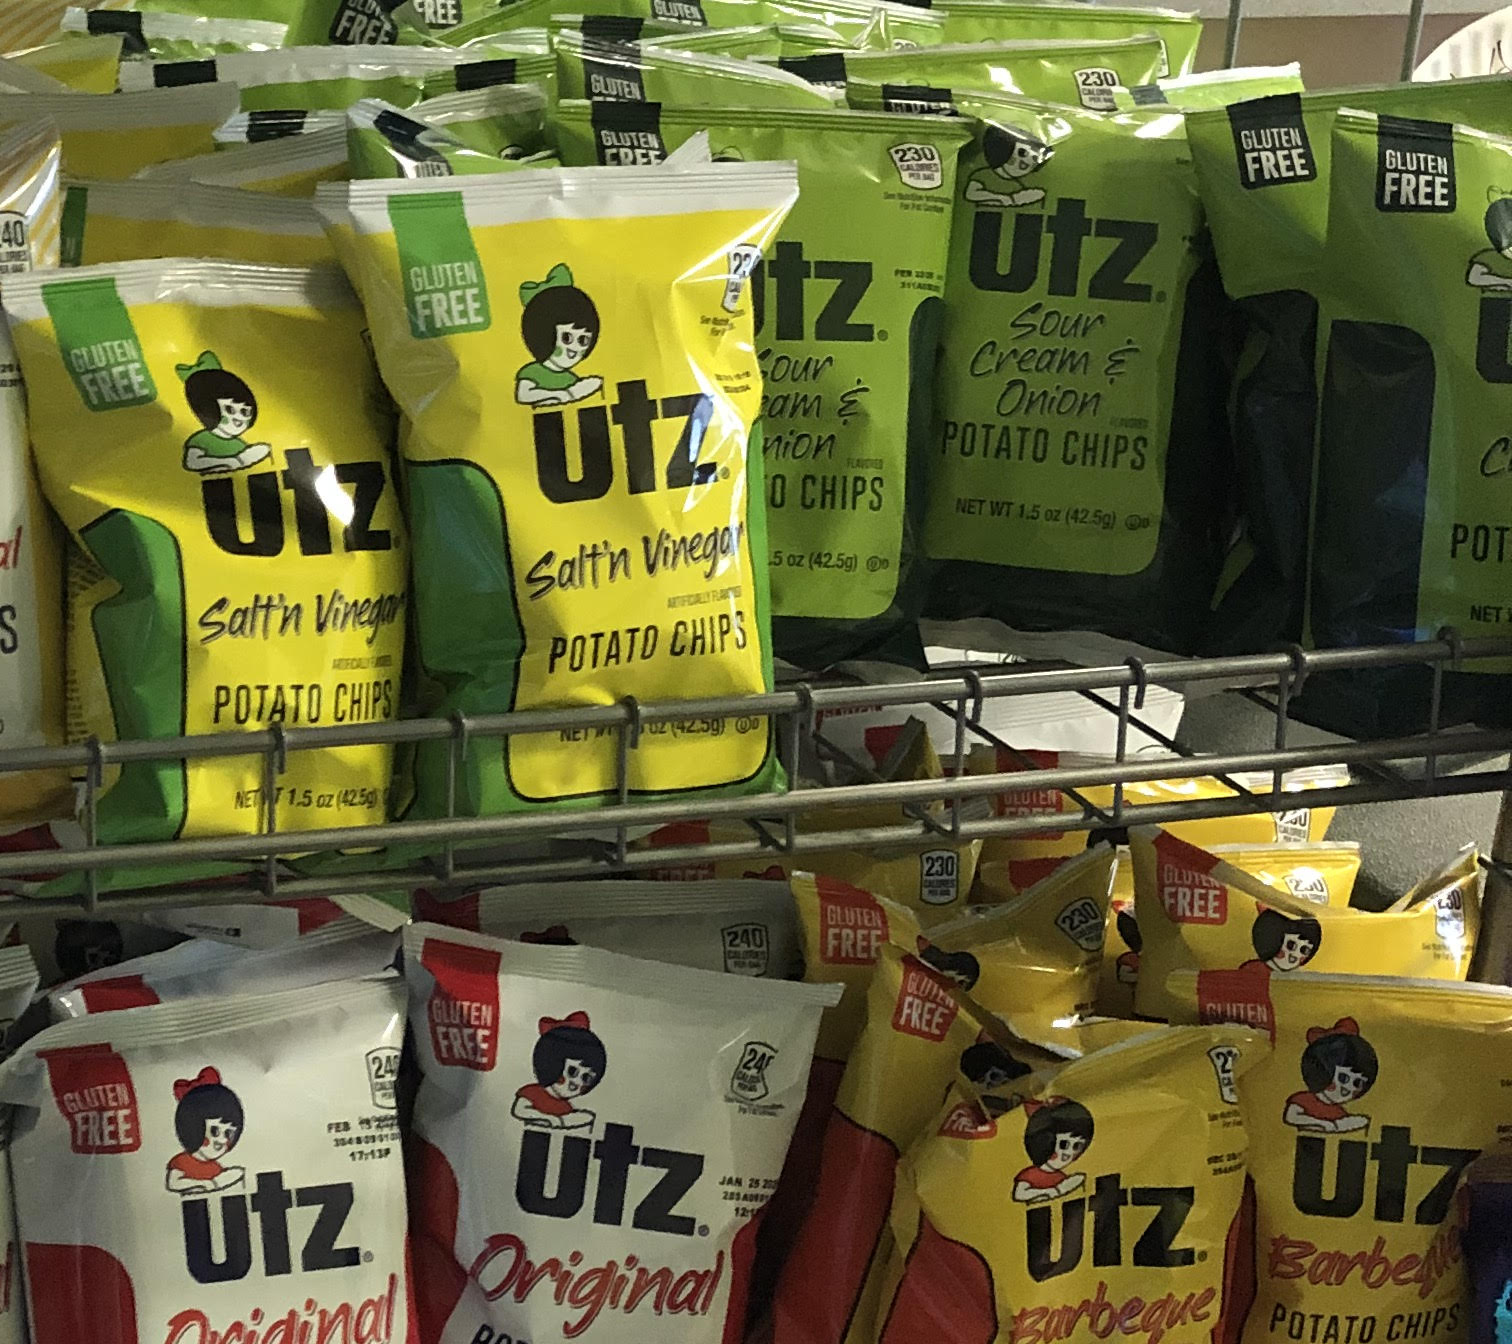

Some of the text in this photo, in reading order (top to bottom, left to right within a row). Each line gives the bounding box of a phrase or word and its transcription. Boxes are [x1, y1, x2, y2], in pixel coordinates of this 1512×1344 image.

[1079, 69, 1118, 89] 230
[600, 128, 660, 150] GLUTEN
[893, 144, 936, 164] 230
[1241, 128, 1302, 151] GLUTEN
[1245, 152, 1309, 182] FREE
[1385, 151, 1449, 175] GLUTEN
[1384, 175, 1450, 208] FREE
[410, 261, 478, 292] GLUTEN
[416, 288, 484, 331] FREE
[1009, 302, 1108, 341] Sour
[970, 338, 1141, 384] Cream &
[995, 379, 1102, 418] Onion
[942, 421, 1148, 471] POTATO CHIPS
[801, 476, 883, 513] CHIPS
[956, 498, 1117, 530] NET WT 1.5 oz (42.5g)
[314, 589, 406, 646] Vinegar
[548, 611, 748, 674] POTATO CHIPS
[214, 680, 393, 724] POTATO CHIPS
[924, 854, 955, 877] 230
[827, 905, 881, 927] GLUTEN
[725, 930, 764, 947] 240
[432, 999, 491, 1027] GLUTEN
[63, 1083, 129, 1114] GLUTEN
[470, 1233, 725, 1338] Original
[1271, 1303, 1460, 1344] POTATO CHIPS
